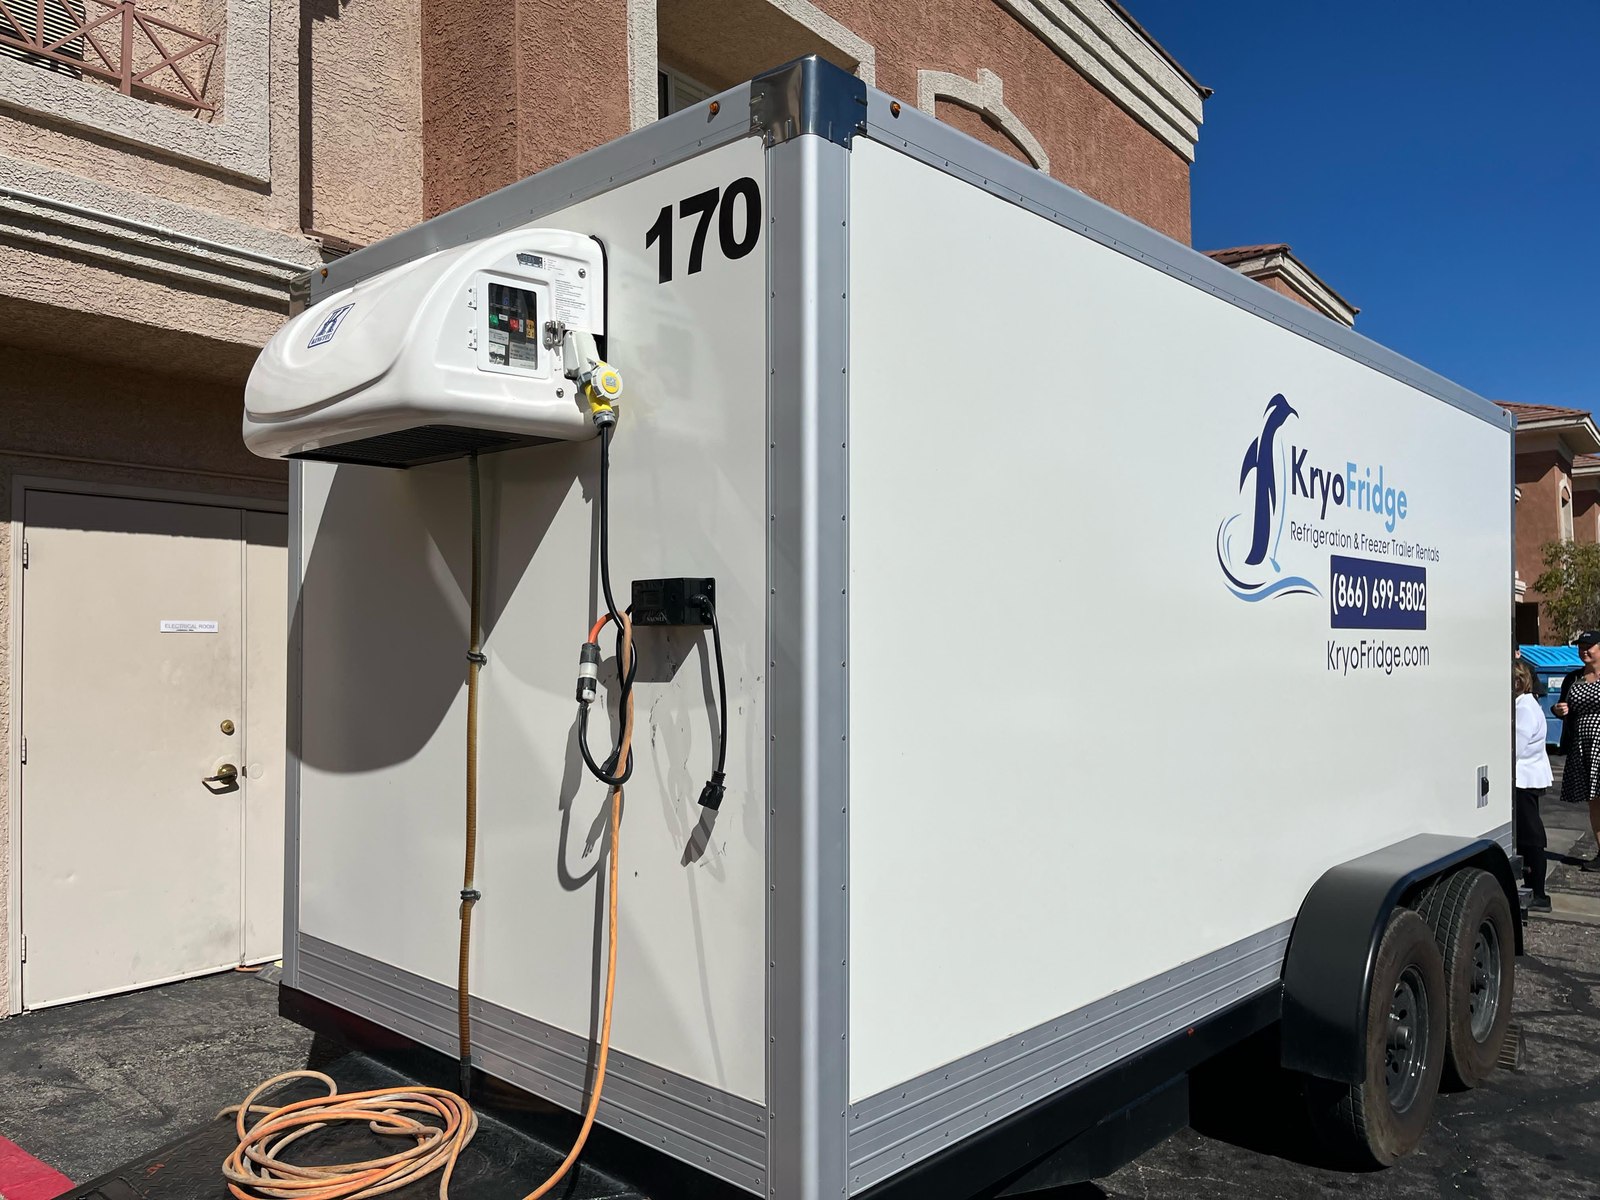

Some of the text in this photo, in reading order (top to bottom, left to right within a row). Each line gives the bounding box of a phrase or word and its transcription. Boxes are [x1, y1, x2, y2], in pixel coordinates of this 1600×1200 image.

[645, 176, 762, 285] 170
[1291, 445, 1408, 533] KryoFridge
[1290, 521, 1440, 562] Refrigeration & Freezer Trailer Rentals
[1332, 572, 1426, 617] (866) 699-5802
[1327, 639, 1431, 677] KryoFridge.com
